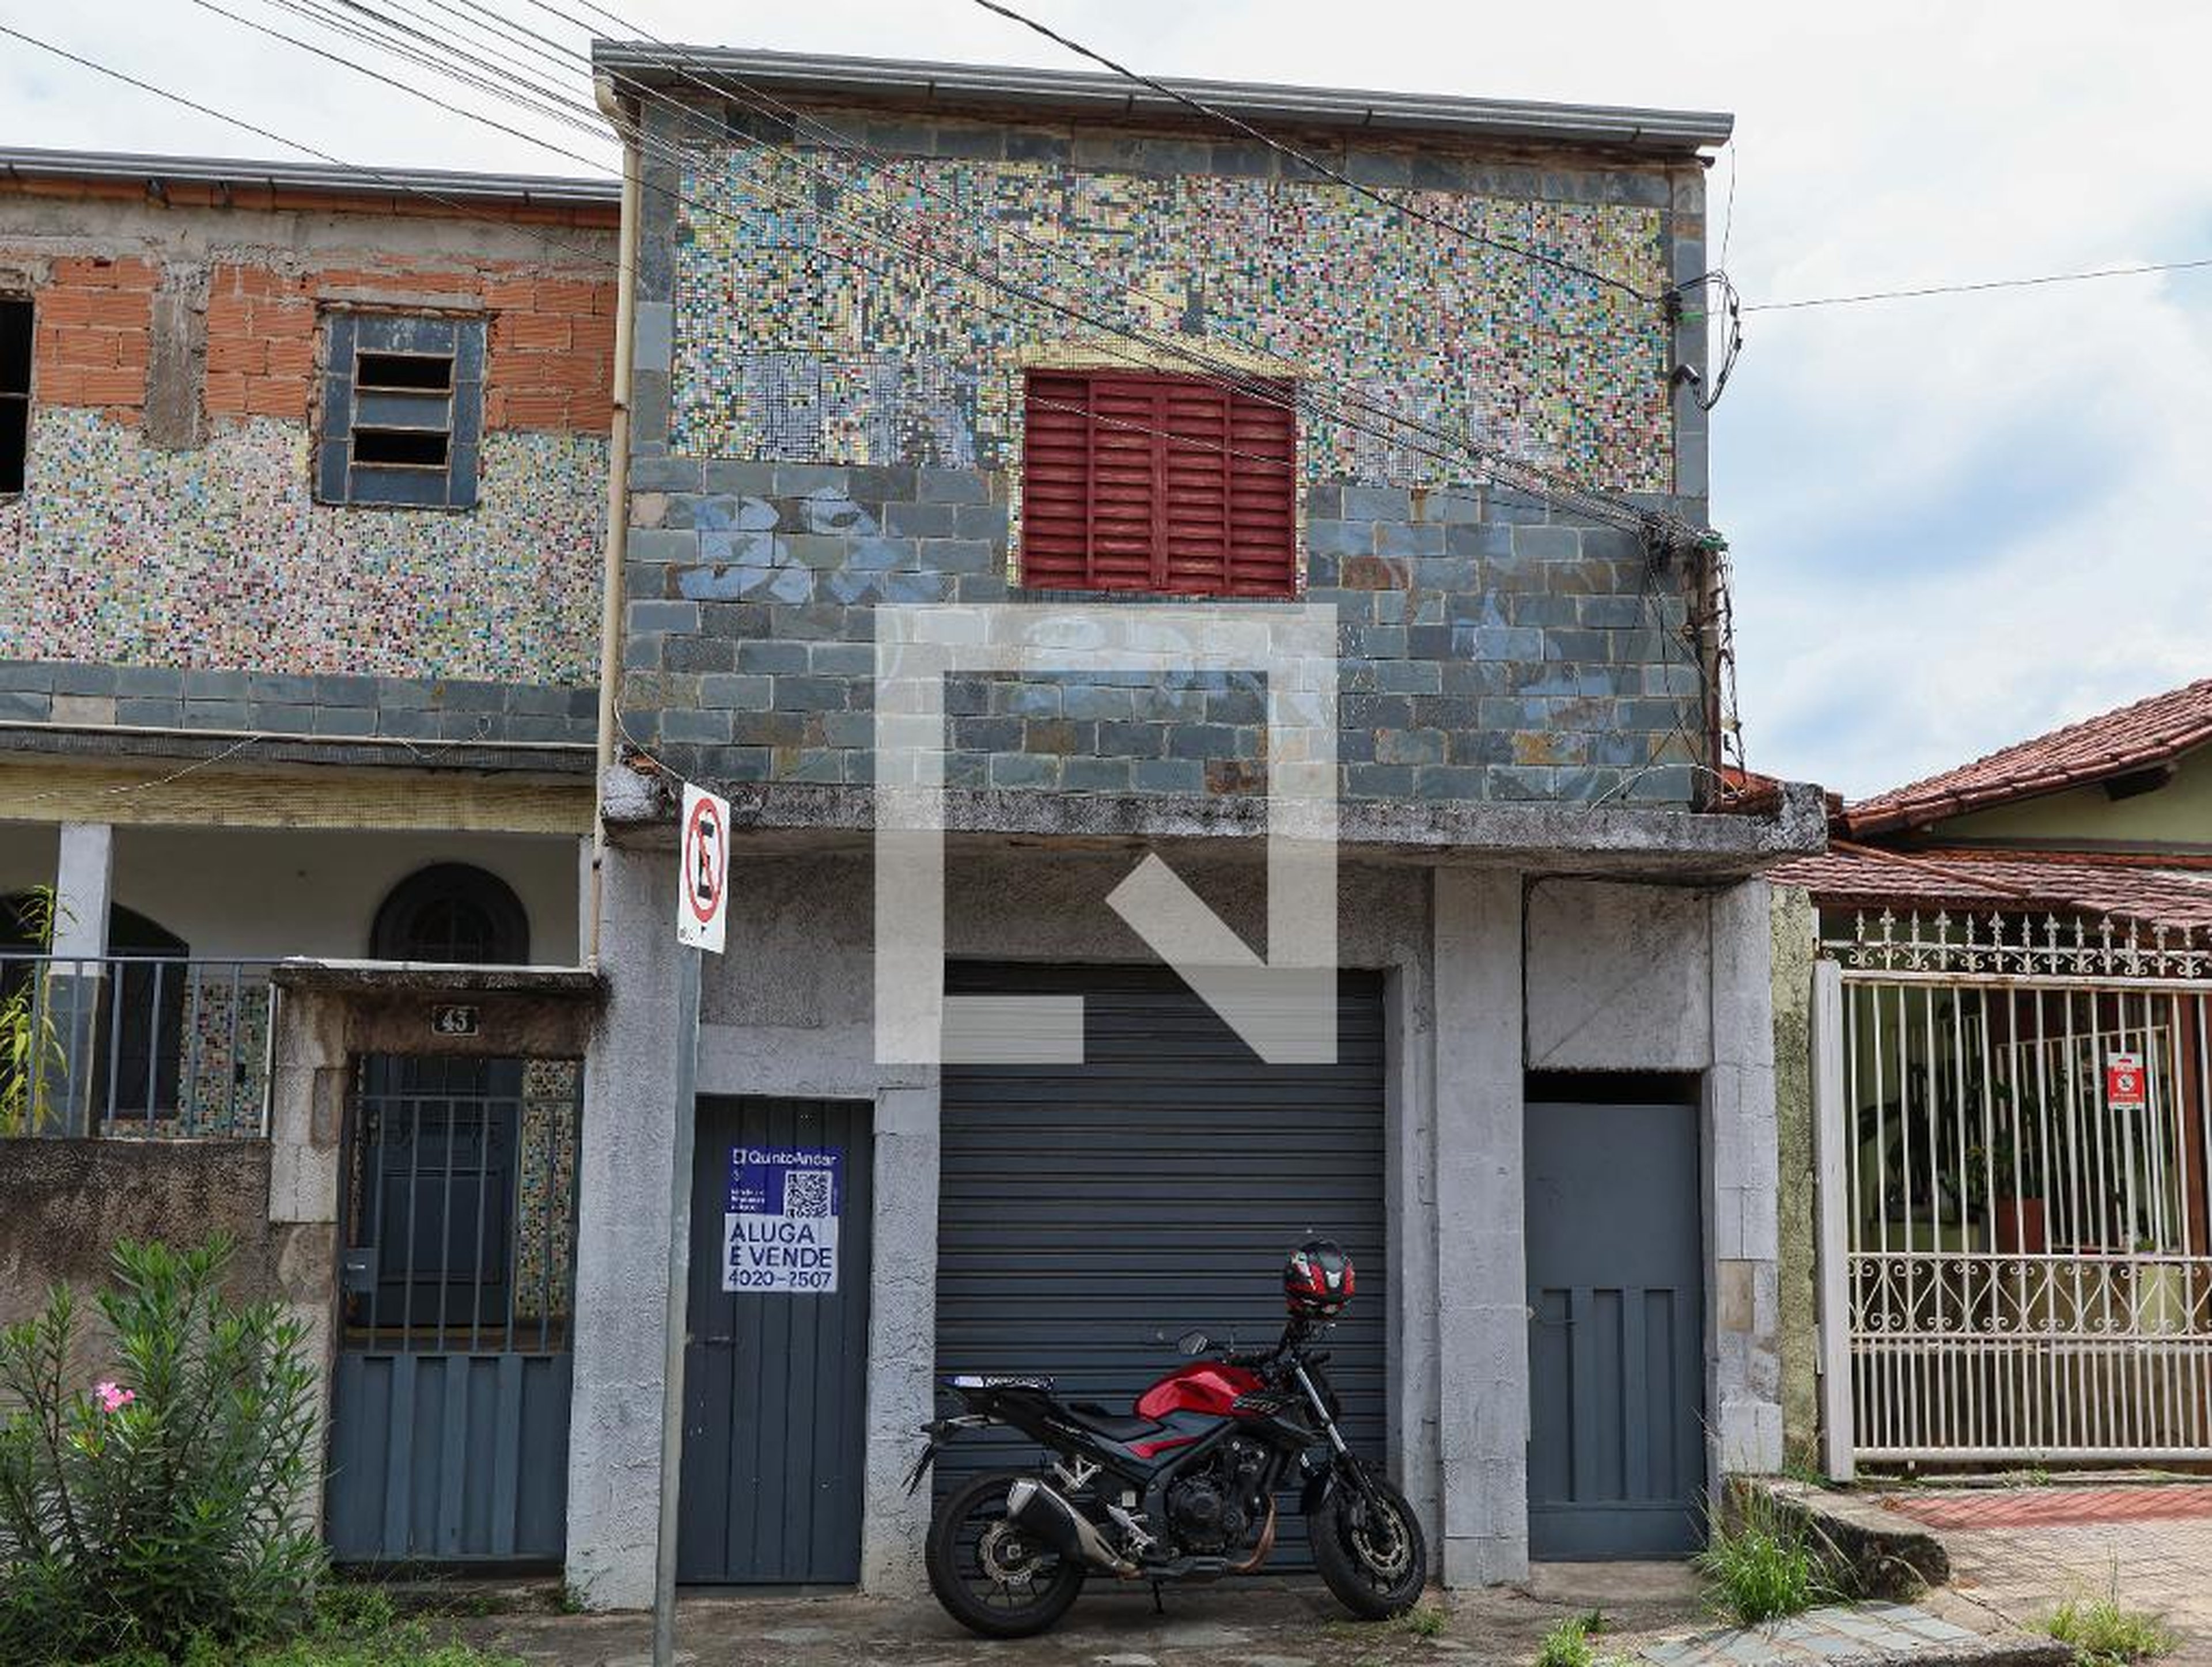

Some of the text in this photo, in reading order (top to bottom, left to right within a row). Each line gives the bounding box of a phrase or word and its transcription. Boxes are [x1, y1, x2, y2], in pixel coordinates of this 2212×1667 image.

[730, 1222, 815, 1244] ALUGA
[730, 1247, 832, 1268] E VENDE
